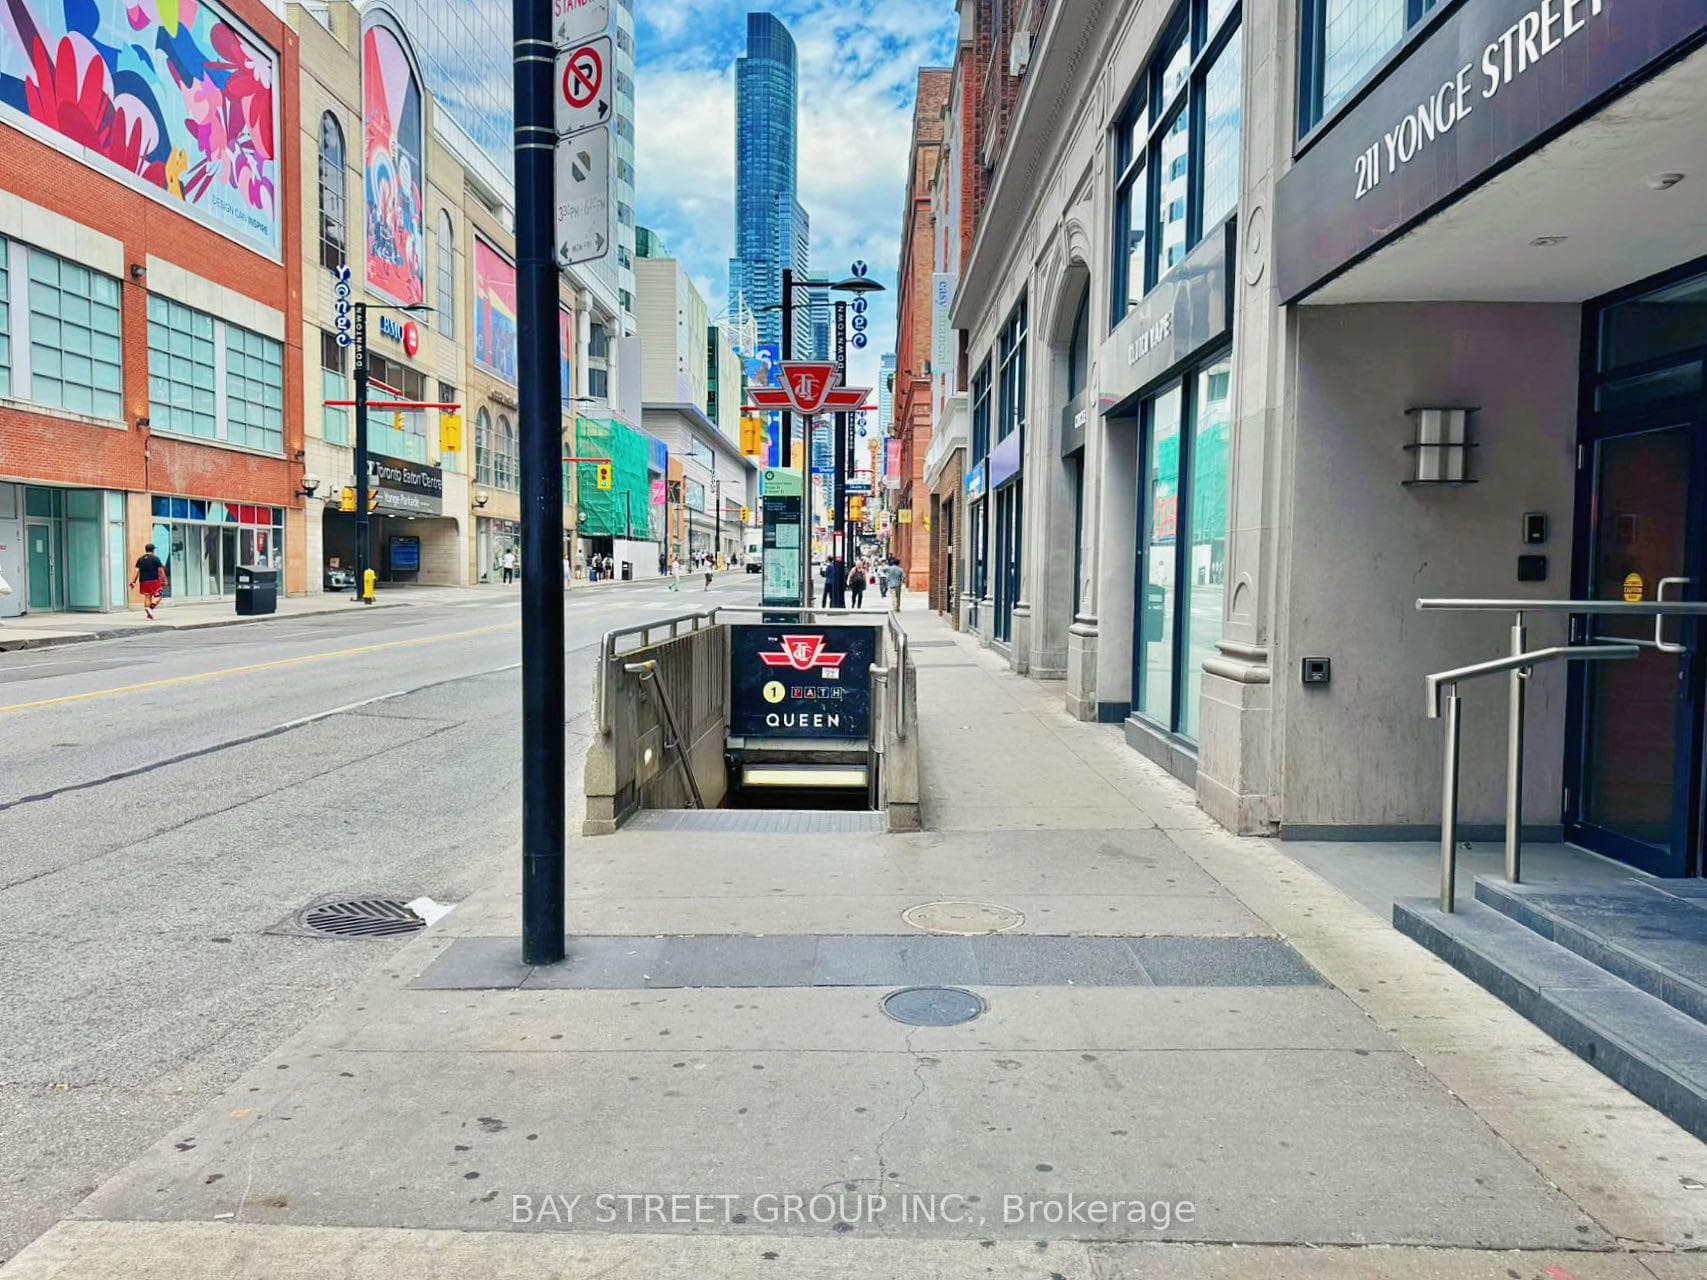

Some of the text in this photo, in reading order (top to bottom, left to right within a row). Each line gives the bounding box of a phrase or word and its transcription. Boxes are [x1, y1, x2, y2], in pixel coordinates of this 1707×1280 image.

[1354, 141, 1380, 200] 211
[1384, 63, 1473, 174] YONGE
[356, 305, 364, 368] DOWNTOWN
[380, 315, 403, 344] BMO
[838, 304, 846, 369] DOWNTOWN
[375, 460, 442, 490] Toronto Eaton Centre
[793, 687, 842, 698] PATH
[766, 713, 840, 728] QUEEN
